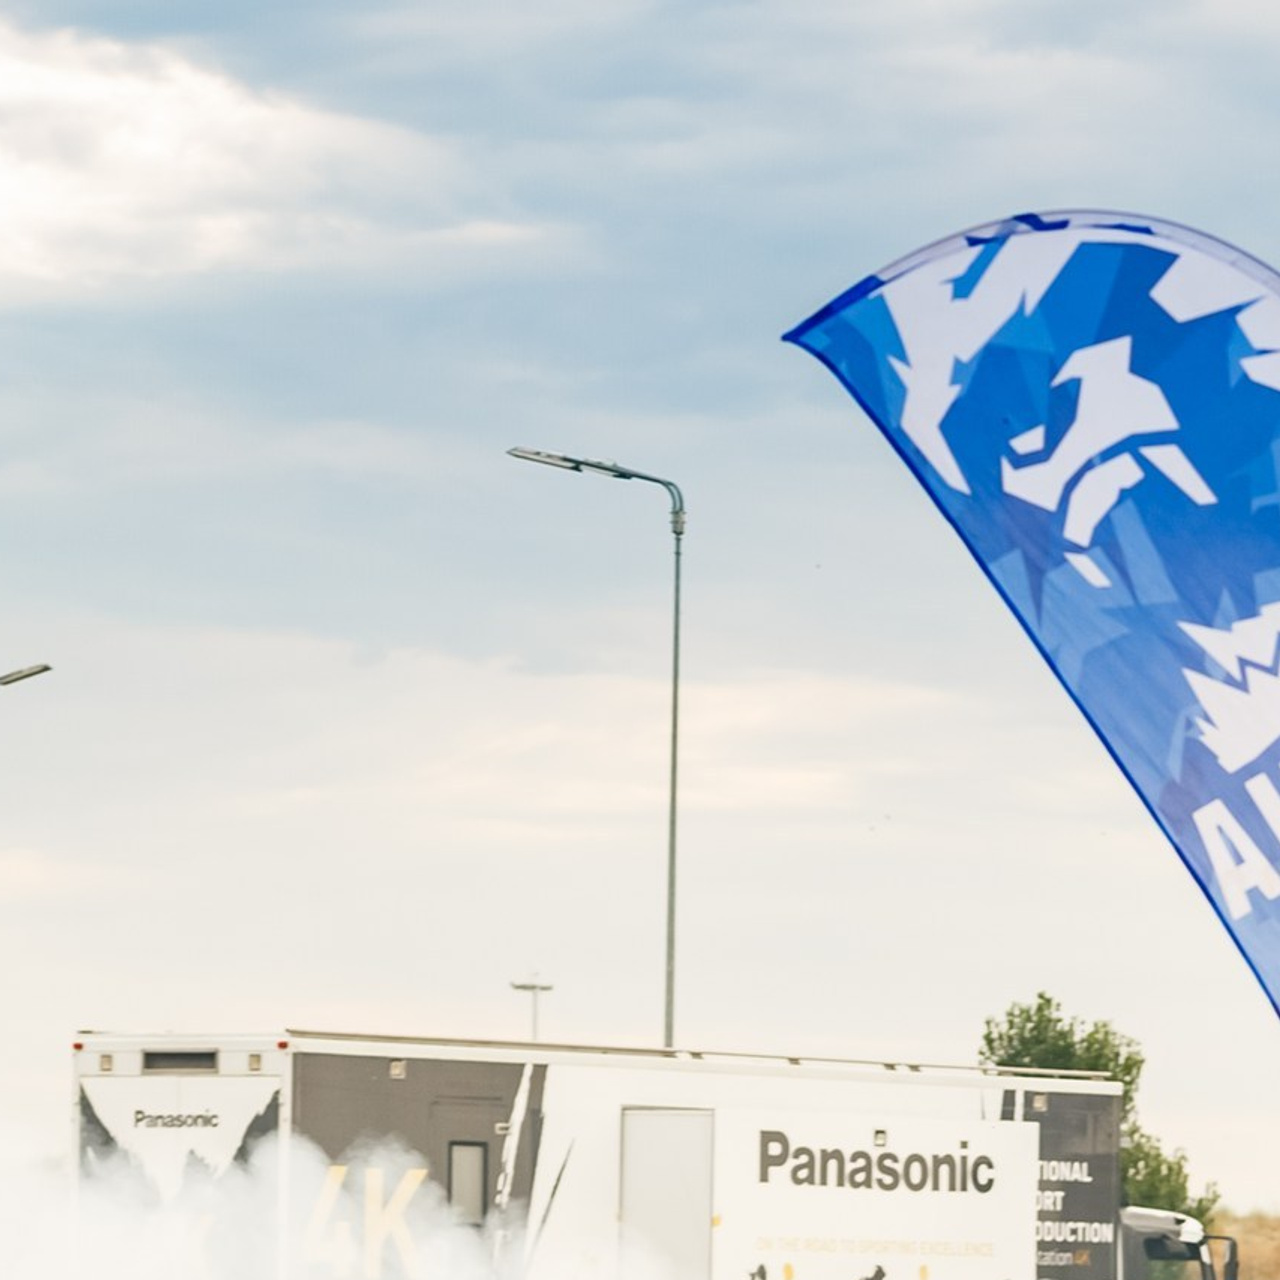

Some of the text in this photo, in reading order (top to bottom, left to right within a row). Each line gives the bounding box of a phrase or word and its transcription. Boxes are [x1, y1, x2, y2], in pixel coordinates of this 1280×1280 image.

[134, 1109, 219, 1128] Panasonic
[759, 1130, 994, 1193] Panasonic
[309, 1165, 428, 1279] 4K
